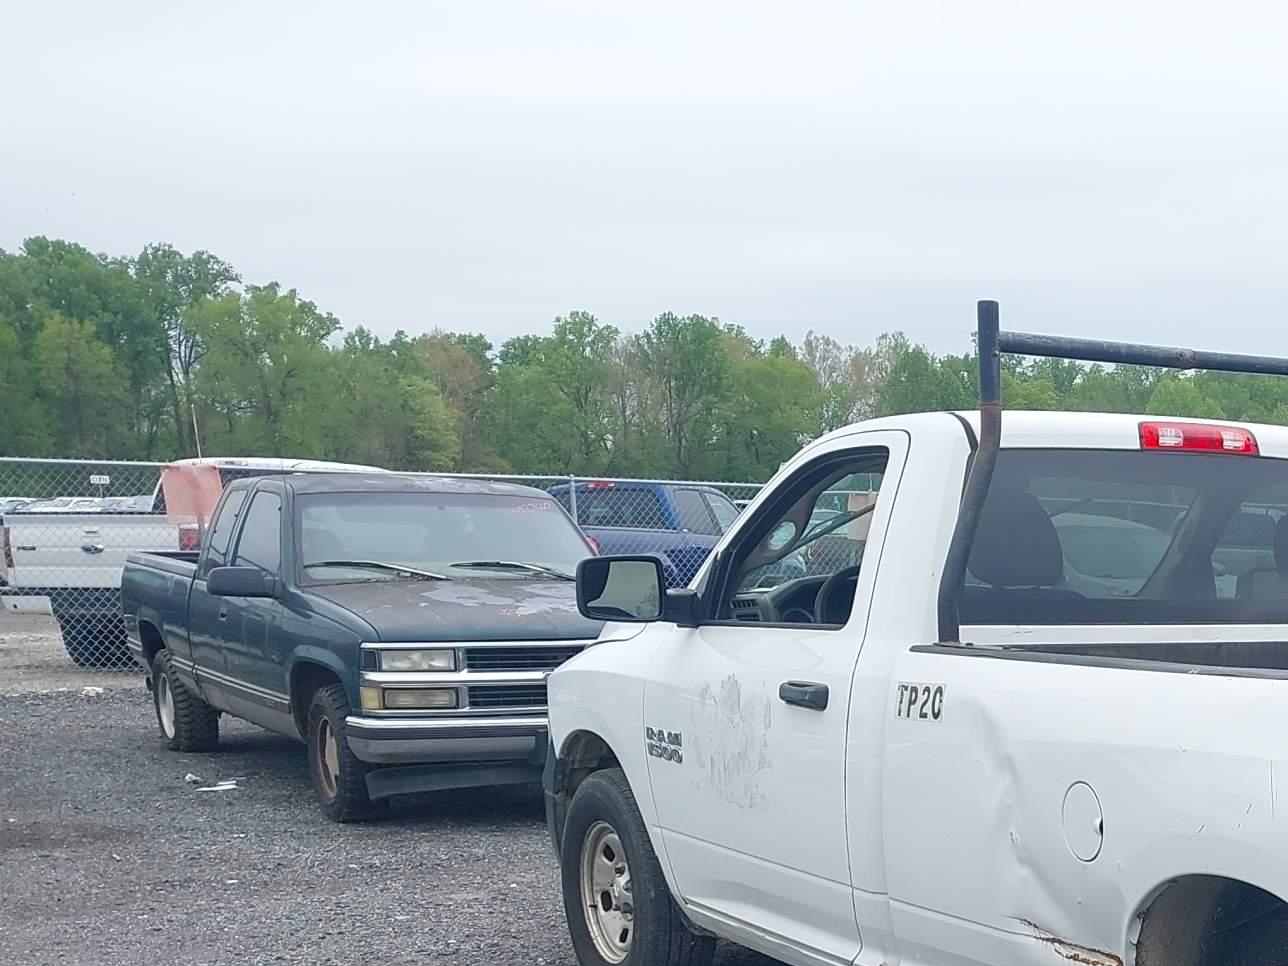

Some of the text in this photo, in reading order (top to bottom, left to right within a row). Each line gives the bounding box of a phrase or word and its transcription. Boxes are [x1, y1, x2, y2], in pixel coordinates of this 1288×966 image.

[897, 684, 943, 720] TP20
[646, 727, 682, 747] RAM
[647, 742, 682, 764] 1500
